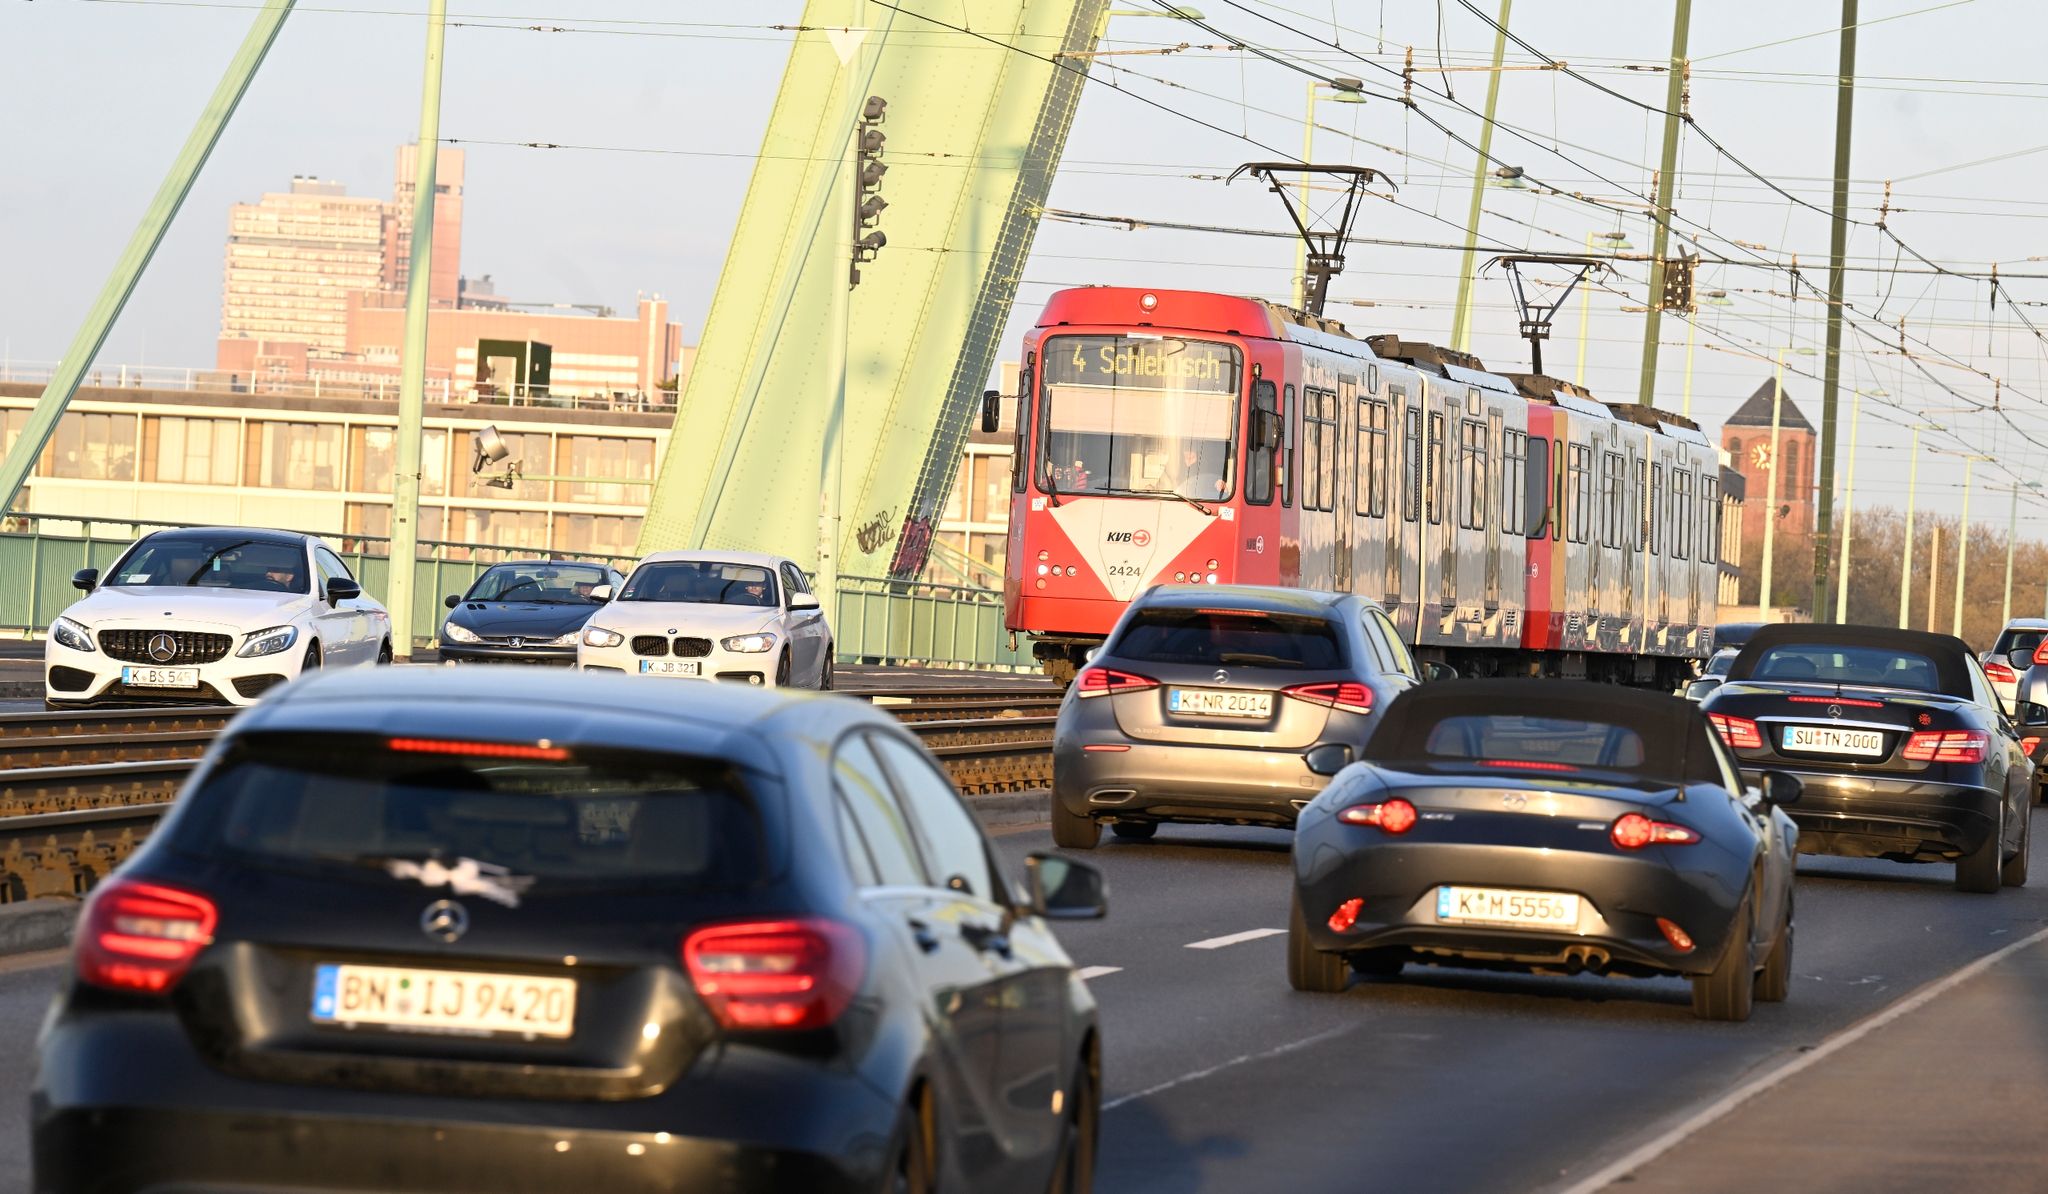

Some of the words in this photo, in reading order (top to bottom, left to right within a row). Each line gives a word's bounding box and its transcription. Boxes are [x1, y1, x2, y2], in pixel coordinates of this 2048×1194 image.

[1072, 344, 1087, 372] 4
[1100, 346, 1220, 380] Schlebusch
[1107, 532, 1132, 543] KVB
[1109, 565, 1141, 577] 2424
[132, 670, 140, 682] K
[149, 670, 165, 683] BS
[648, 662, 655, 672] K
[661, 663, 675, 673] JB
[677, 663, 696, 674] 321
[1182, 694, 1191, 708] K
[1203, 695, 1224, 710] NR
[1229, 696, 1267, 712] 2014
[1796, 730, 1813, 745] SU
[1824, 732, 1840, 747] TN
[1844, 734, 1878, 750] 2000
[1459, 893, 1473, 914] K
[1490, 896, 1503, 915] M
[1509, 896, 1565, 919] 5556
[343, 975, 390, 1012] BN
[422, 980, 465, 1017] IJ
[476, 984, 566, 1024] 9420
